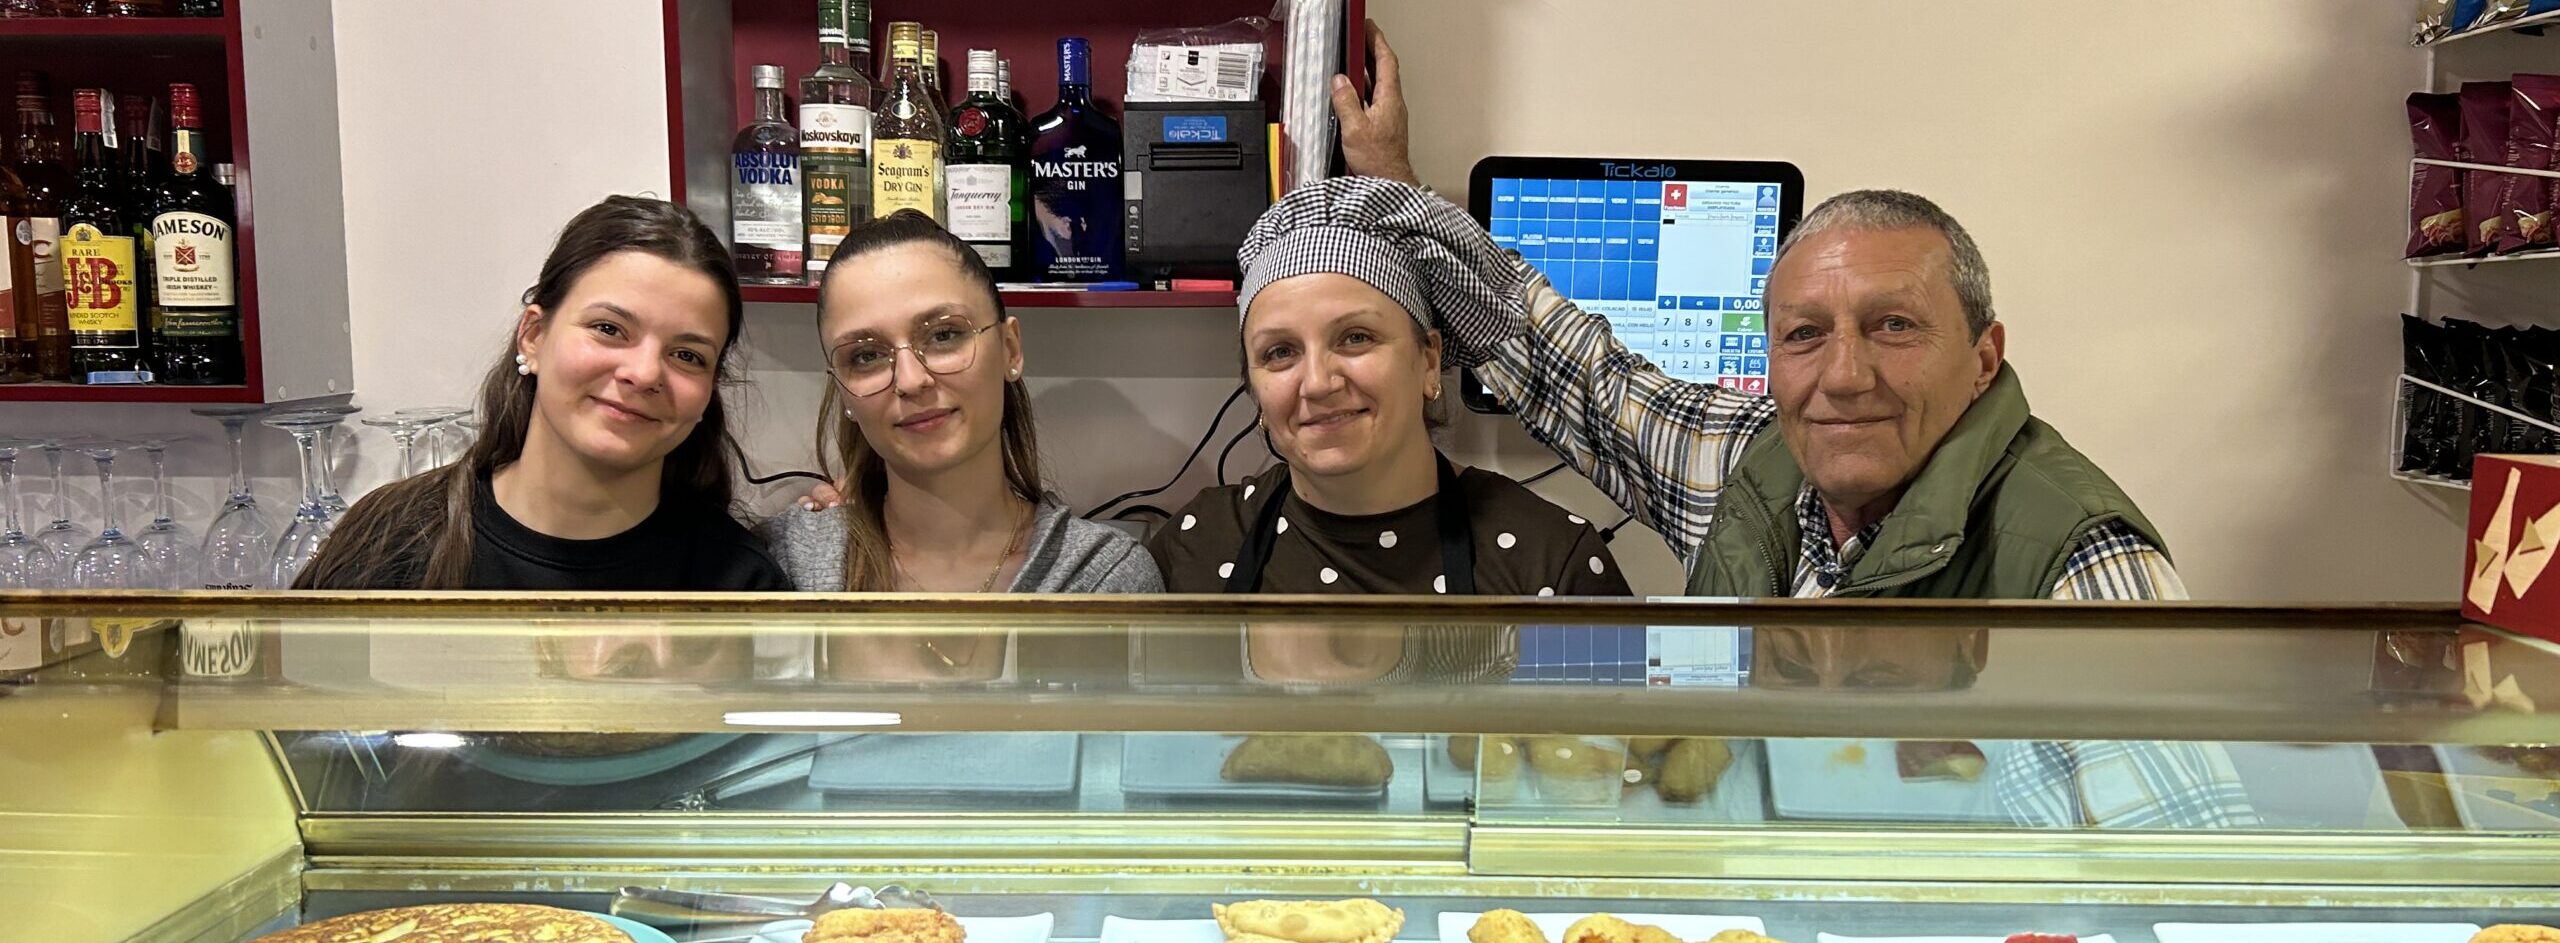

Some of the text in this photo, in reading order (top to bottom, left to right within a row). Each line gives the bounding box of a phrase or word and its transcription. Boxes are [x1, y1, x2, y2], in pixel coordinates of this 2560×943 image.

[1168, 129, 1222, 140] Tickalo
[735, 151, 798, 169] ABSOLUT
[878, 162, 930, 179] Seagram's
[1034, 161, 1118, 178] MASTER'S
[1600, 162, 1677, 178] Tickalo
[739, 168, 793, 185] VODKA
[811, 178, 845, 190] VODKA
[884, 181, 923, 192] DRY GIN
[1067, 181, 1086, 190] GIN
[951, 188, 1002, 203] Tanqueray
[155, 218, 225, 240] JAMESON
[71, 248, 101, 256] RARE
[66, 257, 122, 309] J&B
[1733, 299, 1760, 311] 0,00
[1663, 317, 1713, 327] 7 8 9
[1661, 339, 1712, 348] 4 5 6
[1662, 360, 1710, 369] 1 2 3
